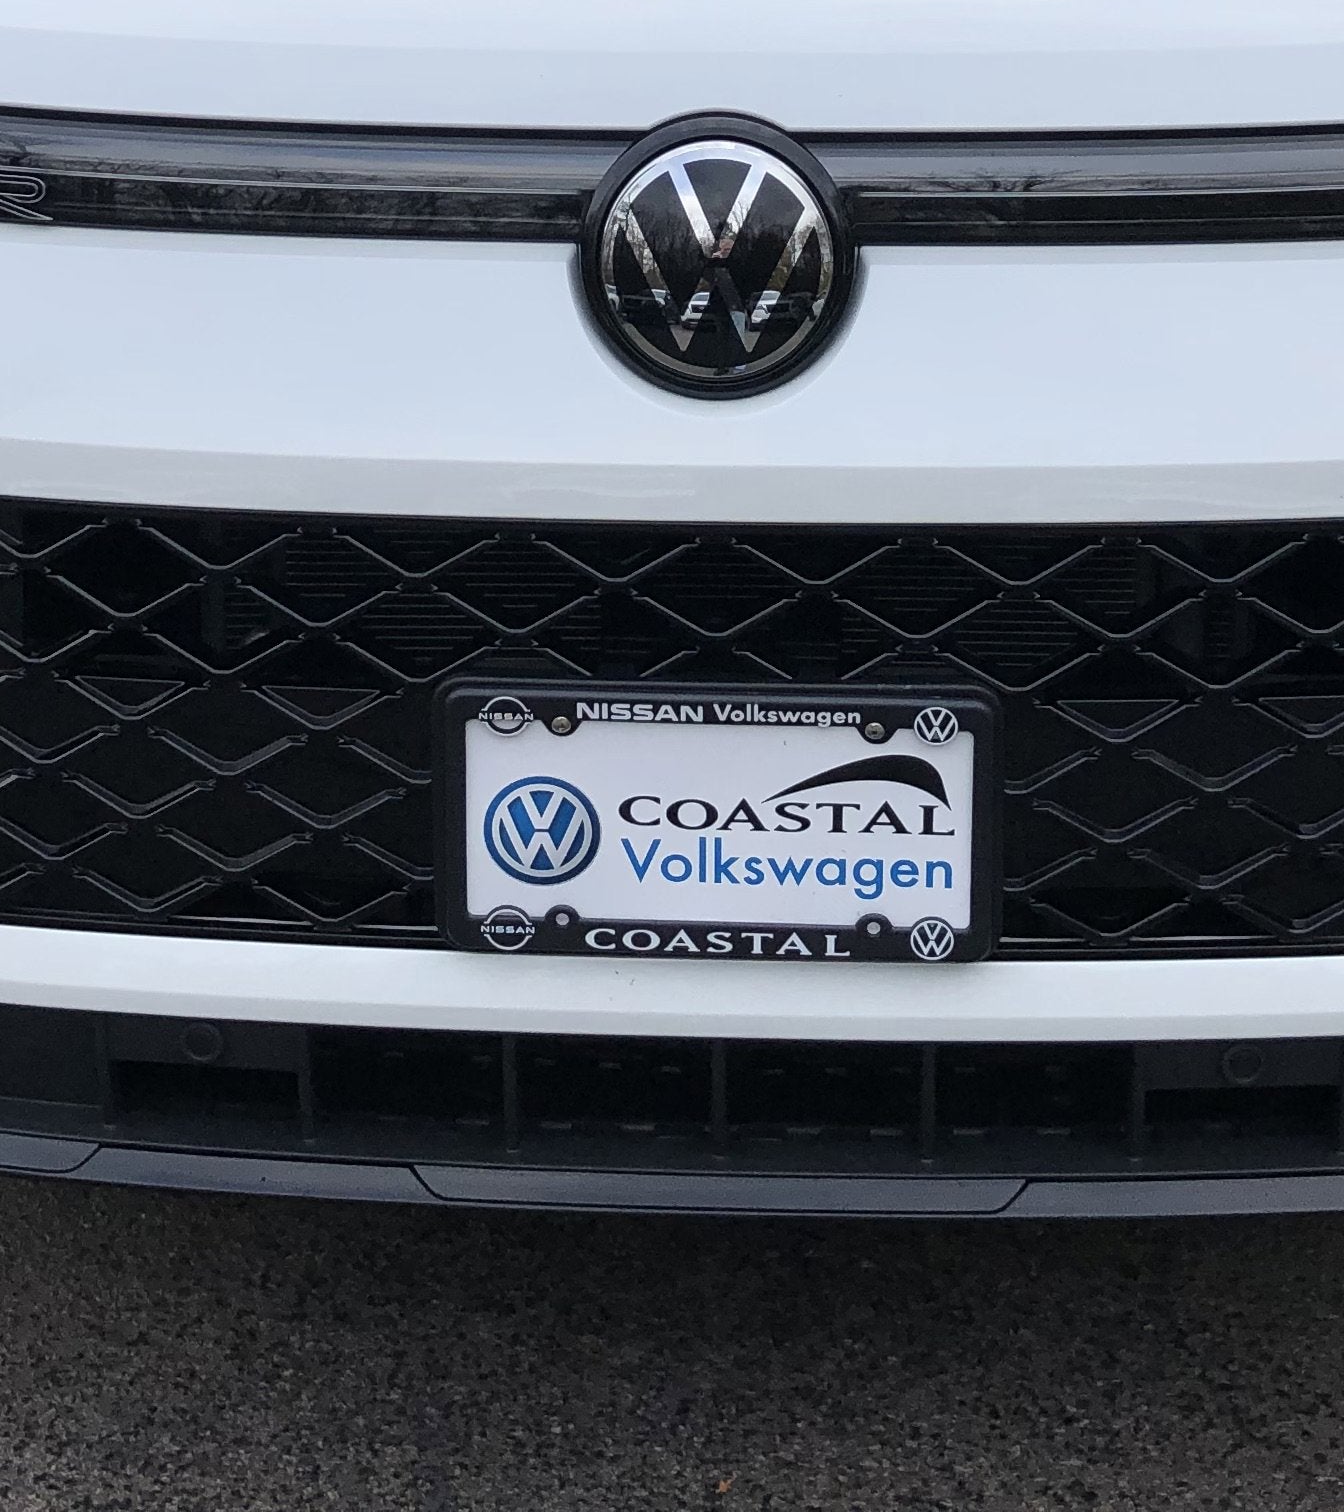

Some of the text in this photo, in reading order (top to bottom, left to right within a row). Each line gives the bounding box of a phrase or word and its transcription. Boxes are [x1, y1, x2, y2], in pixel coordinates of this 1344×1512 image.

[478, 712, 534, 721] NISSAN
[577, 701, 862, 728] NISSAN Volkswagen
[617, 795, 956, 836] COASTAL
[620, 835, 954, 900] Volkswagen
[480, 925, 536, 935] NISSAN
[584, 927, 851, 958] COASTAL
